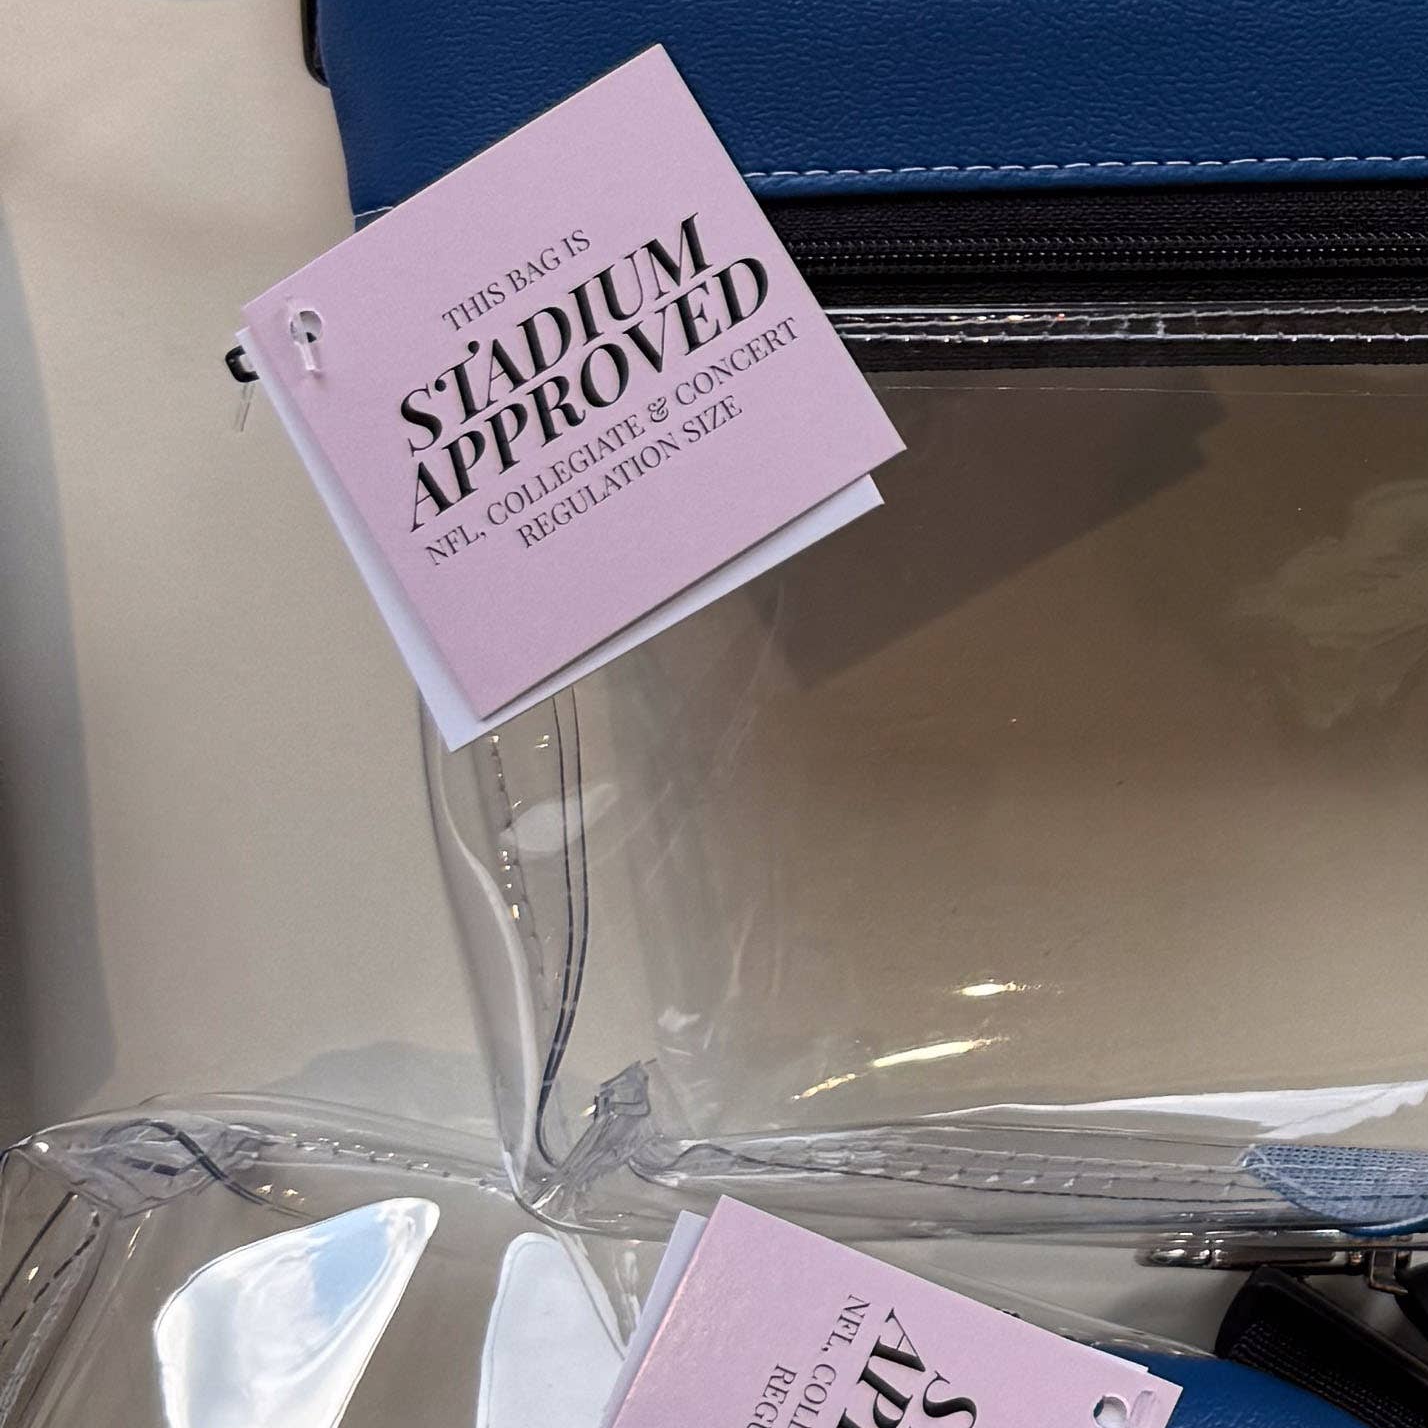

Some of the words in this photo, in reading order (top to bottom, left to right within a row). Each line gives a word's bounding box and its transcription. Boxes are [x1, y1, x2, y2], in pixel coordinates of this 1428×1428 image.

[400, 212, 713, 453] STADIUM
[441, 282, 506, 331] THIS
[505, 247, 561, 293] BAG
[561, 229, 591, 258] IS
[410, 257, 769, 533] APPROVED
[425, 524, 487, 566] NFL,
[486, 414, 646, 526] COLLEGIATE
[647, 396, 669, 423] &
[675, 316, 798, 406] CONCERT
[515, 432, 681, 549] REGULATION
[682, 394, 743, 443] SIZE
[821, 1294, 871, 1352] NFL,
